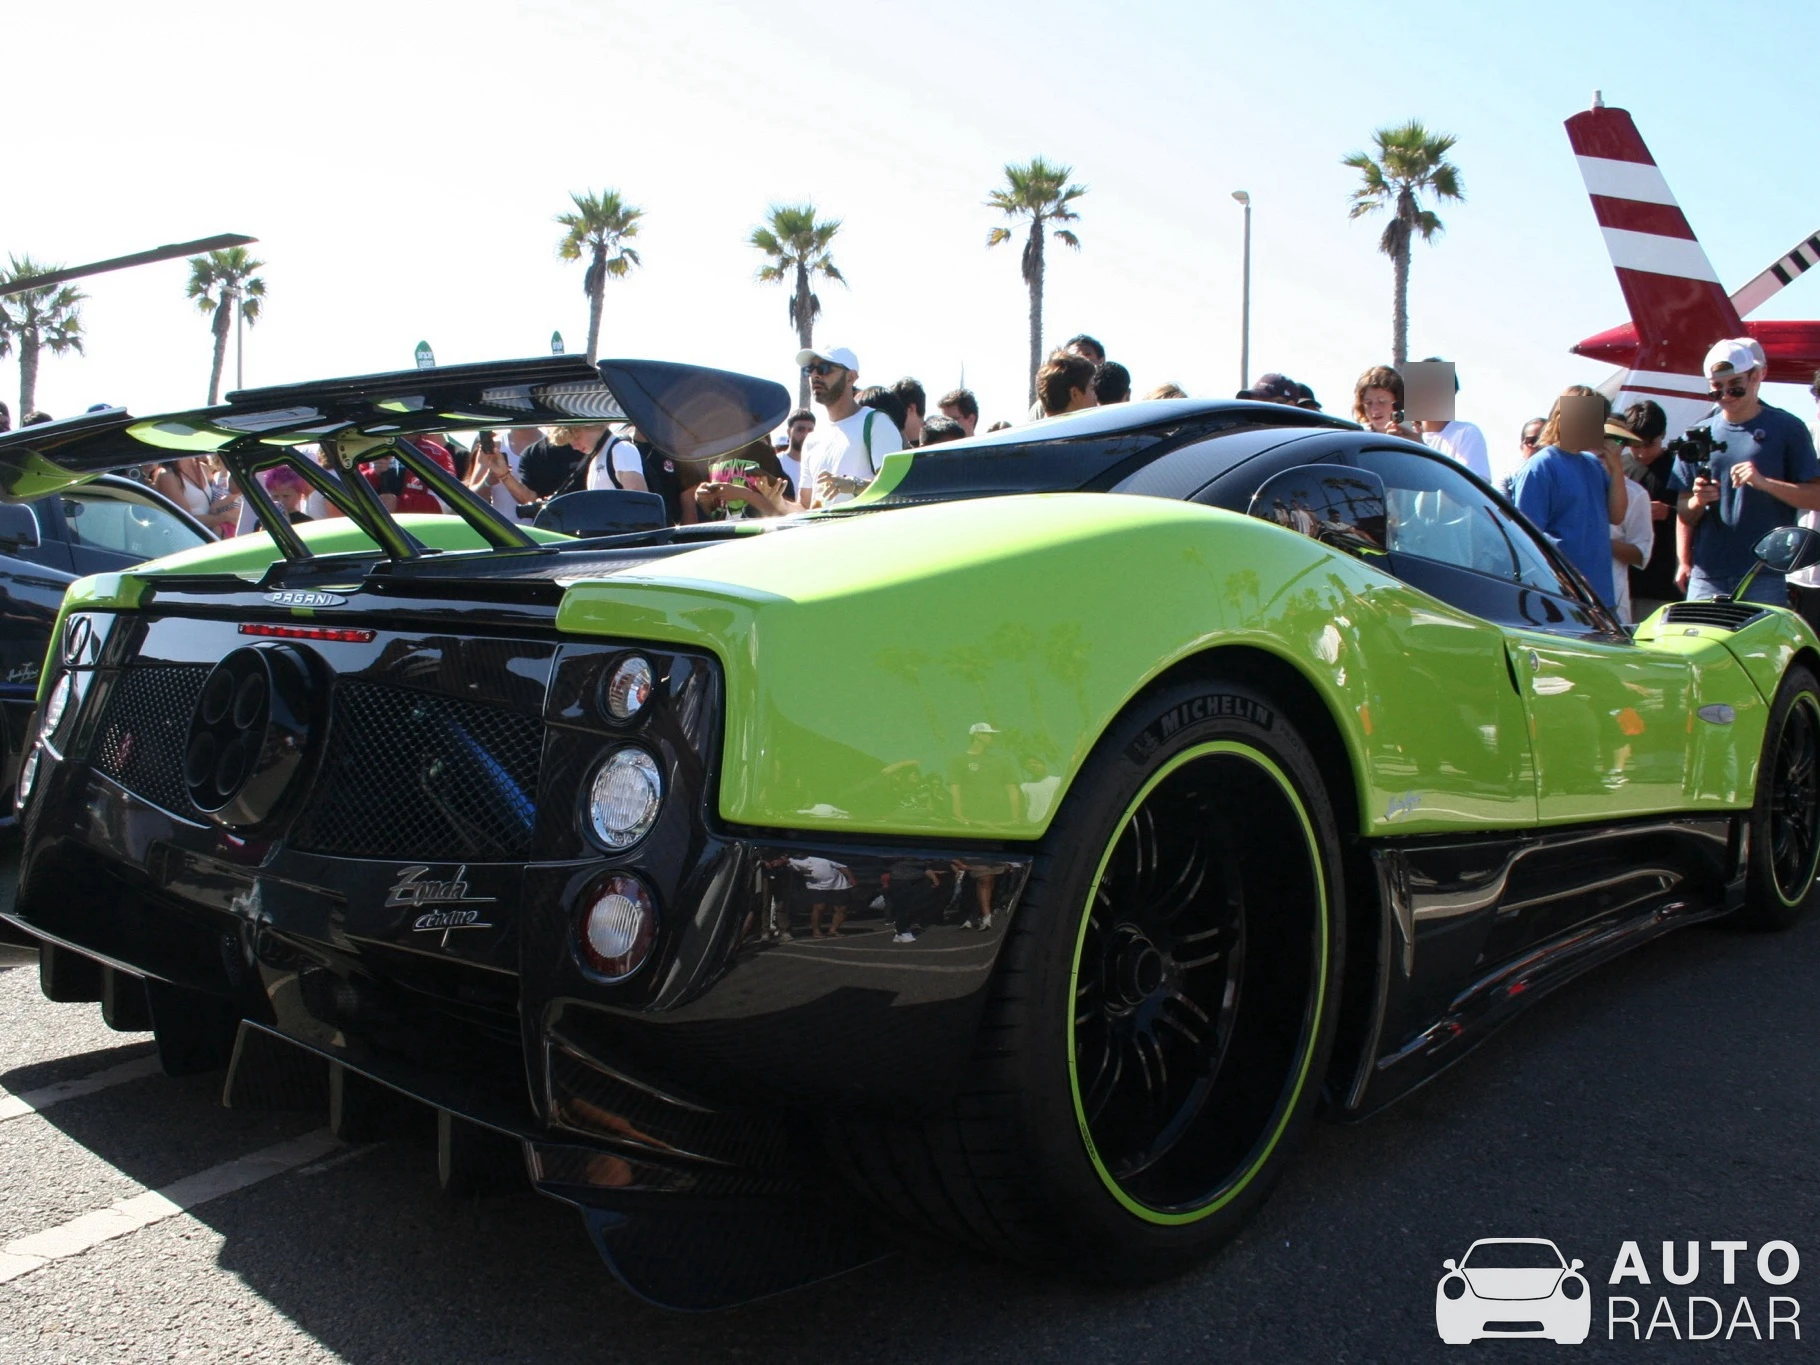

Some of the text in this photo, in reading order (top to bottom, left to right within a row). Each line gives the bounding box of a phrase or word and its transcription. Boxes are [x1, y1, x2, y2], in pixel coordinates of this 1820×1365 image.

[272, 592, 334, 605] PAGANI
[1160, 695, 1270, 738] MICHELIN
[385, 864, 498, 908] Zonda
